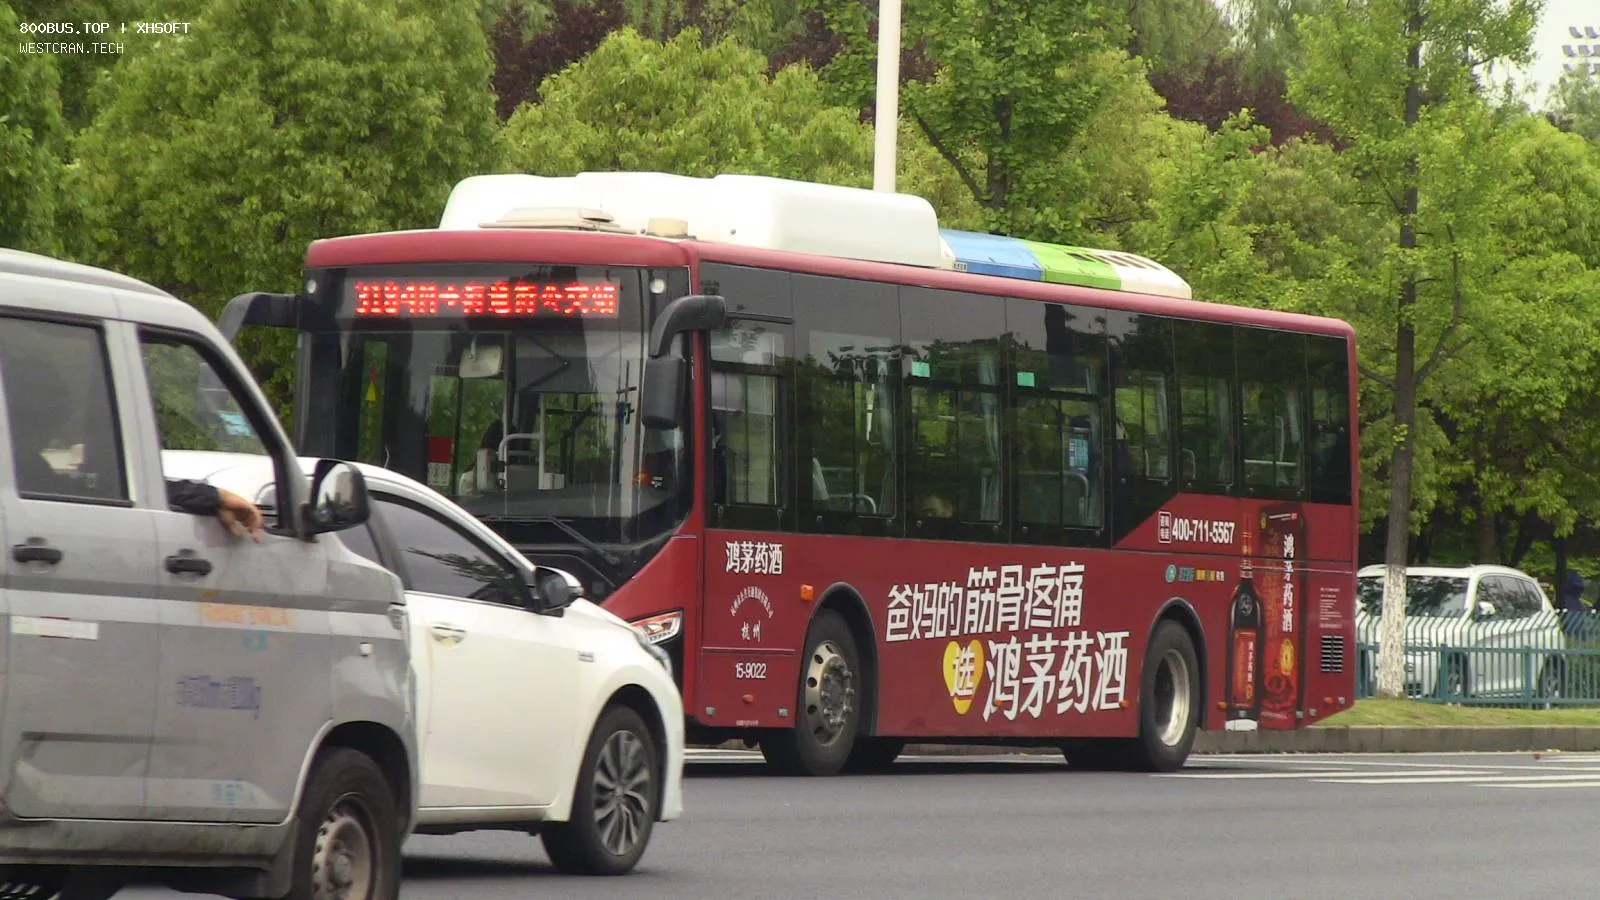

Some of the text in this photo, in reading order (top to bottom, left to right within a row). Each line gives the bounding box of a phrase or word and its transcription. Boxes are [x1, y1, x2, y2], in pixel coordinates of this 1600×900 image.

[1172, 518, 1236, 544] 400-711-5567
[725, 541, 783, 575] 鸿茅药酒
[886, 561, 1085, 642] 爸妈的筋骨疼痛
[735, 662, 767, 679] 15-9022
